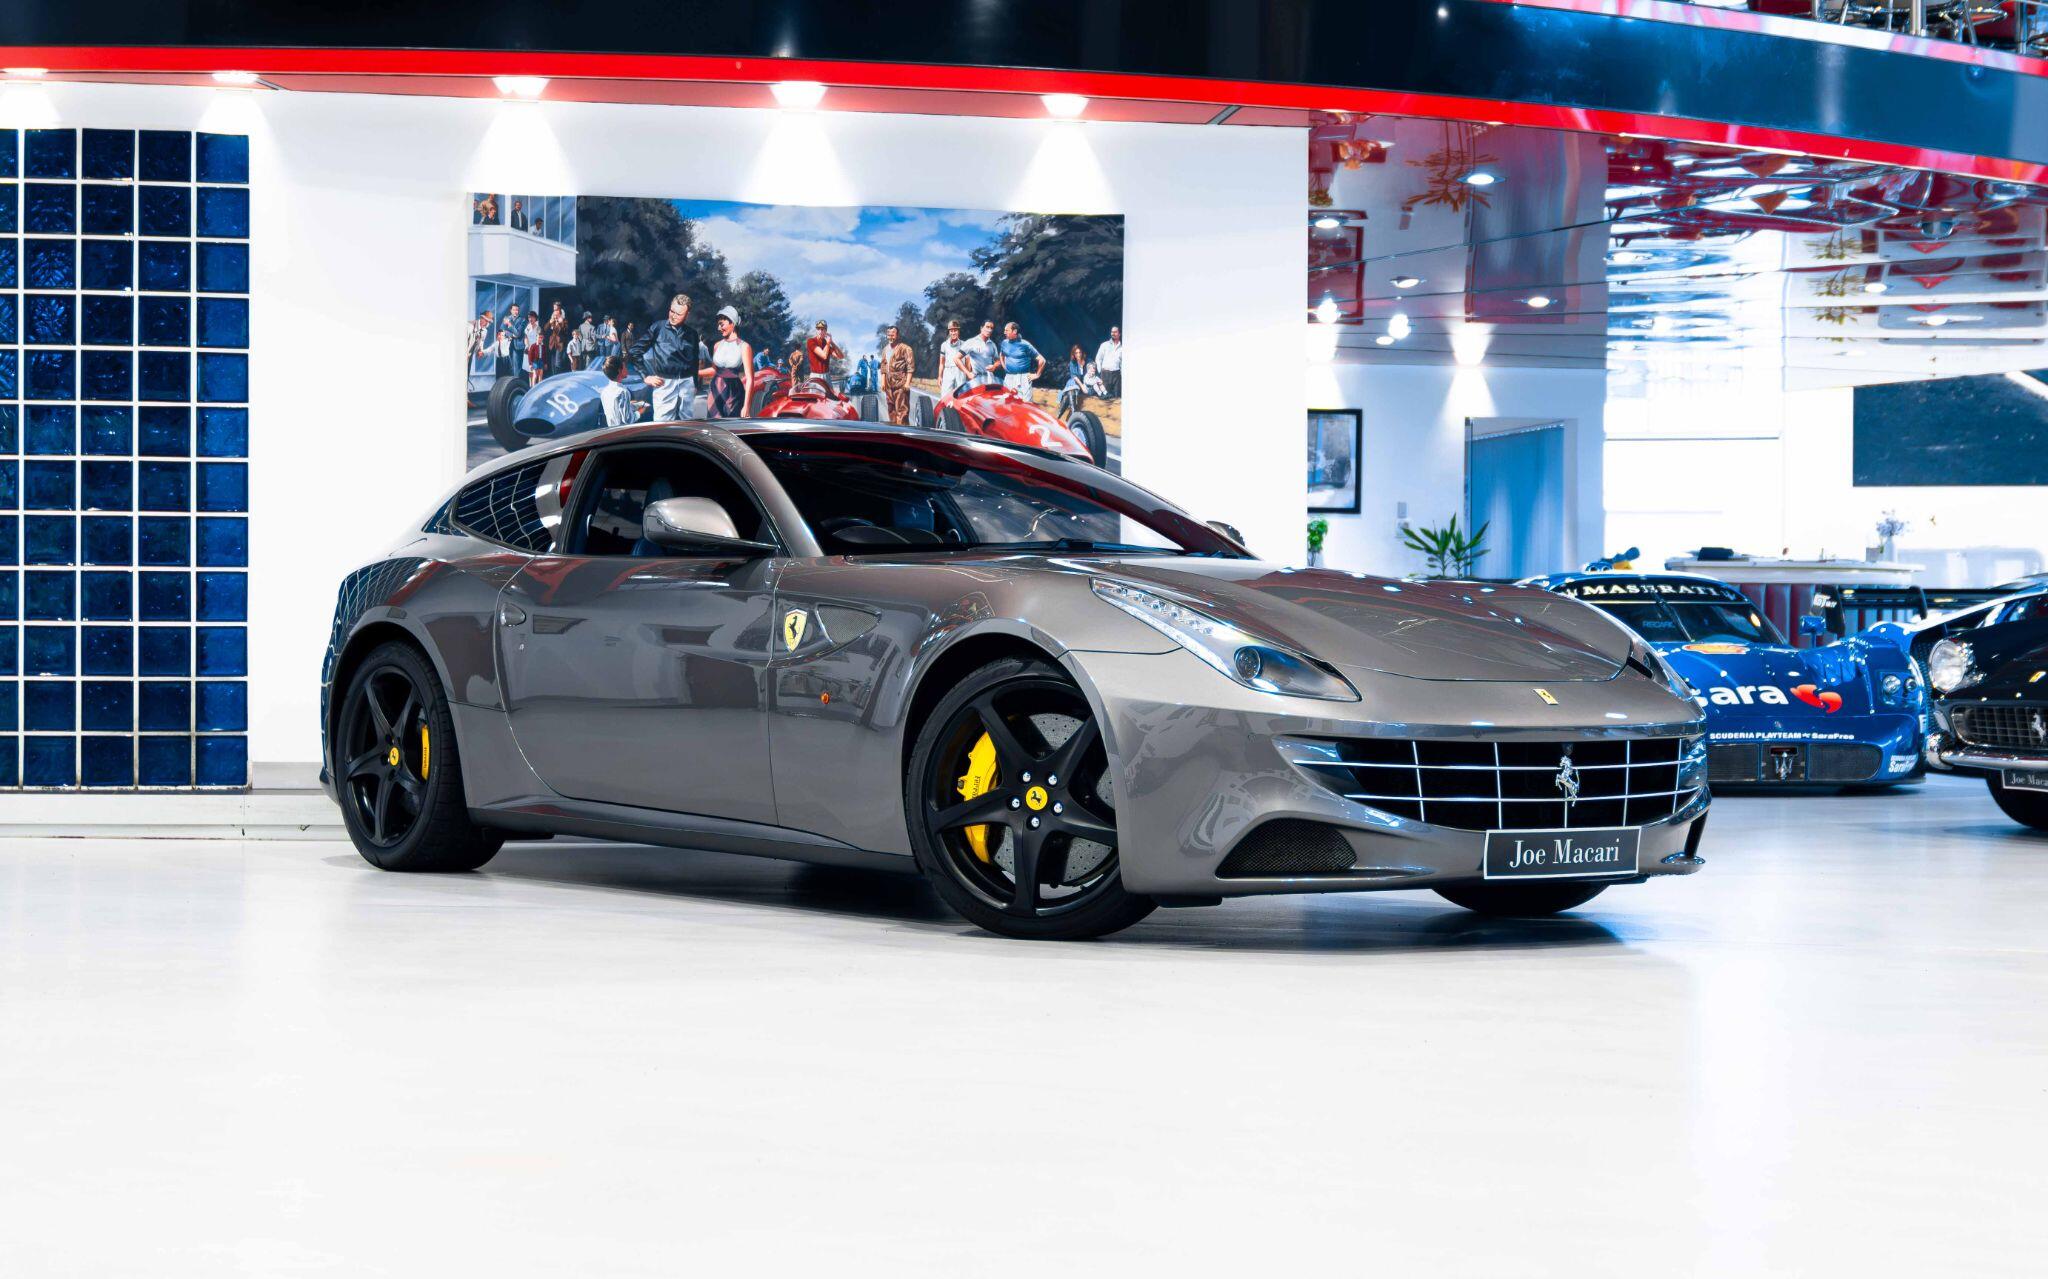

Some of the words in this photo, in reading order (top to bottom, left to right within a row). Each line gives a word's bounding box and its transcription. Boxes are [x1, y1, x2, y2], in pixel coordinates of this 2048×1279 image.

[546, 393, 579, 416] 18
[1582, 584, 1718, 596] MASERATI
[2011, 773, 2025, 785] Joe
[2028, 775, 2048, 787] Maca
[1509, 840, 1546, 868] Joe
[1553, 838, 1620, 864] Macari
